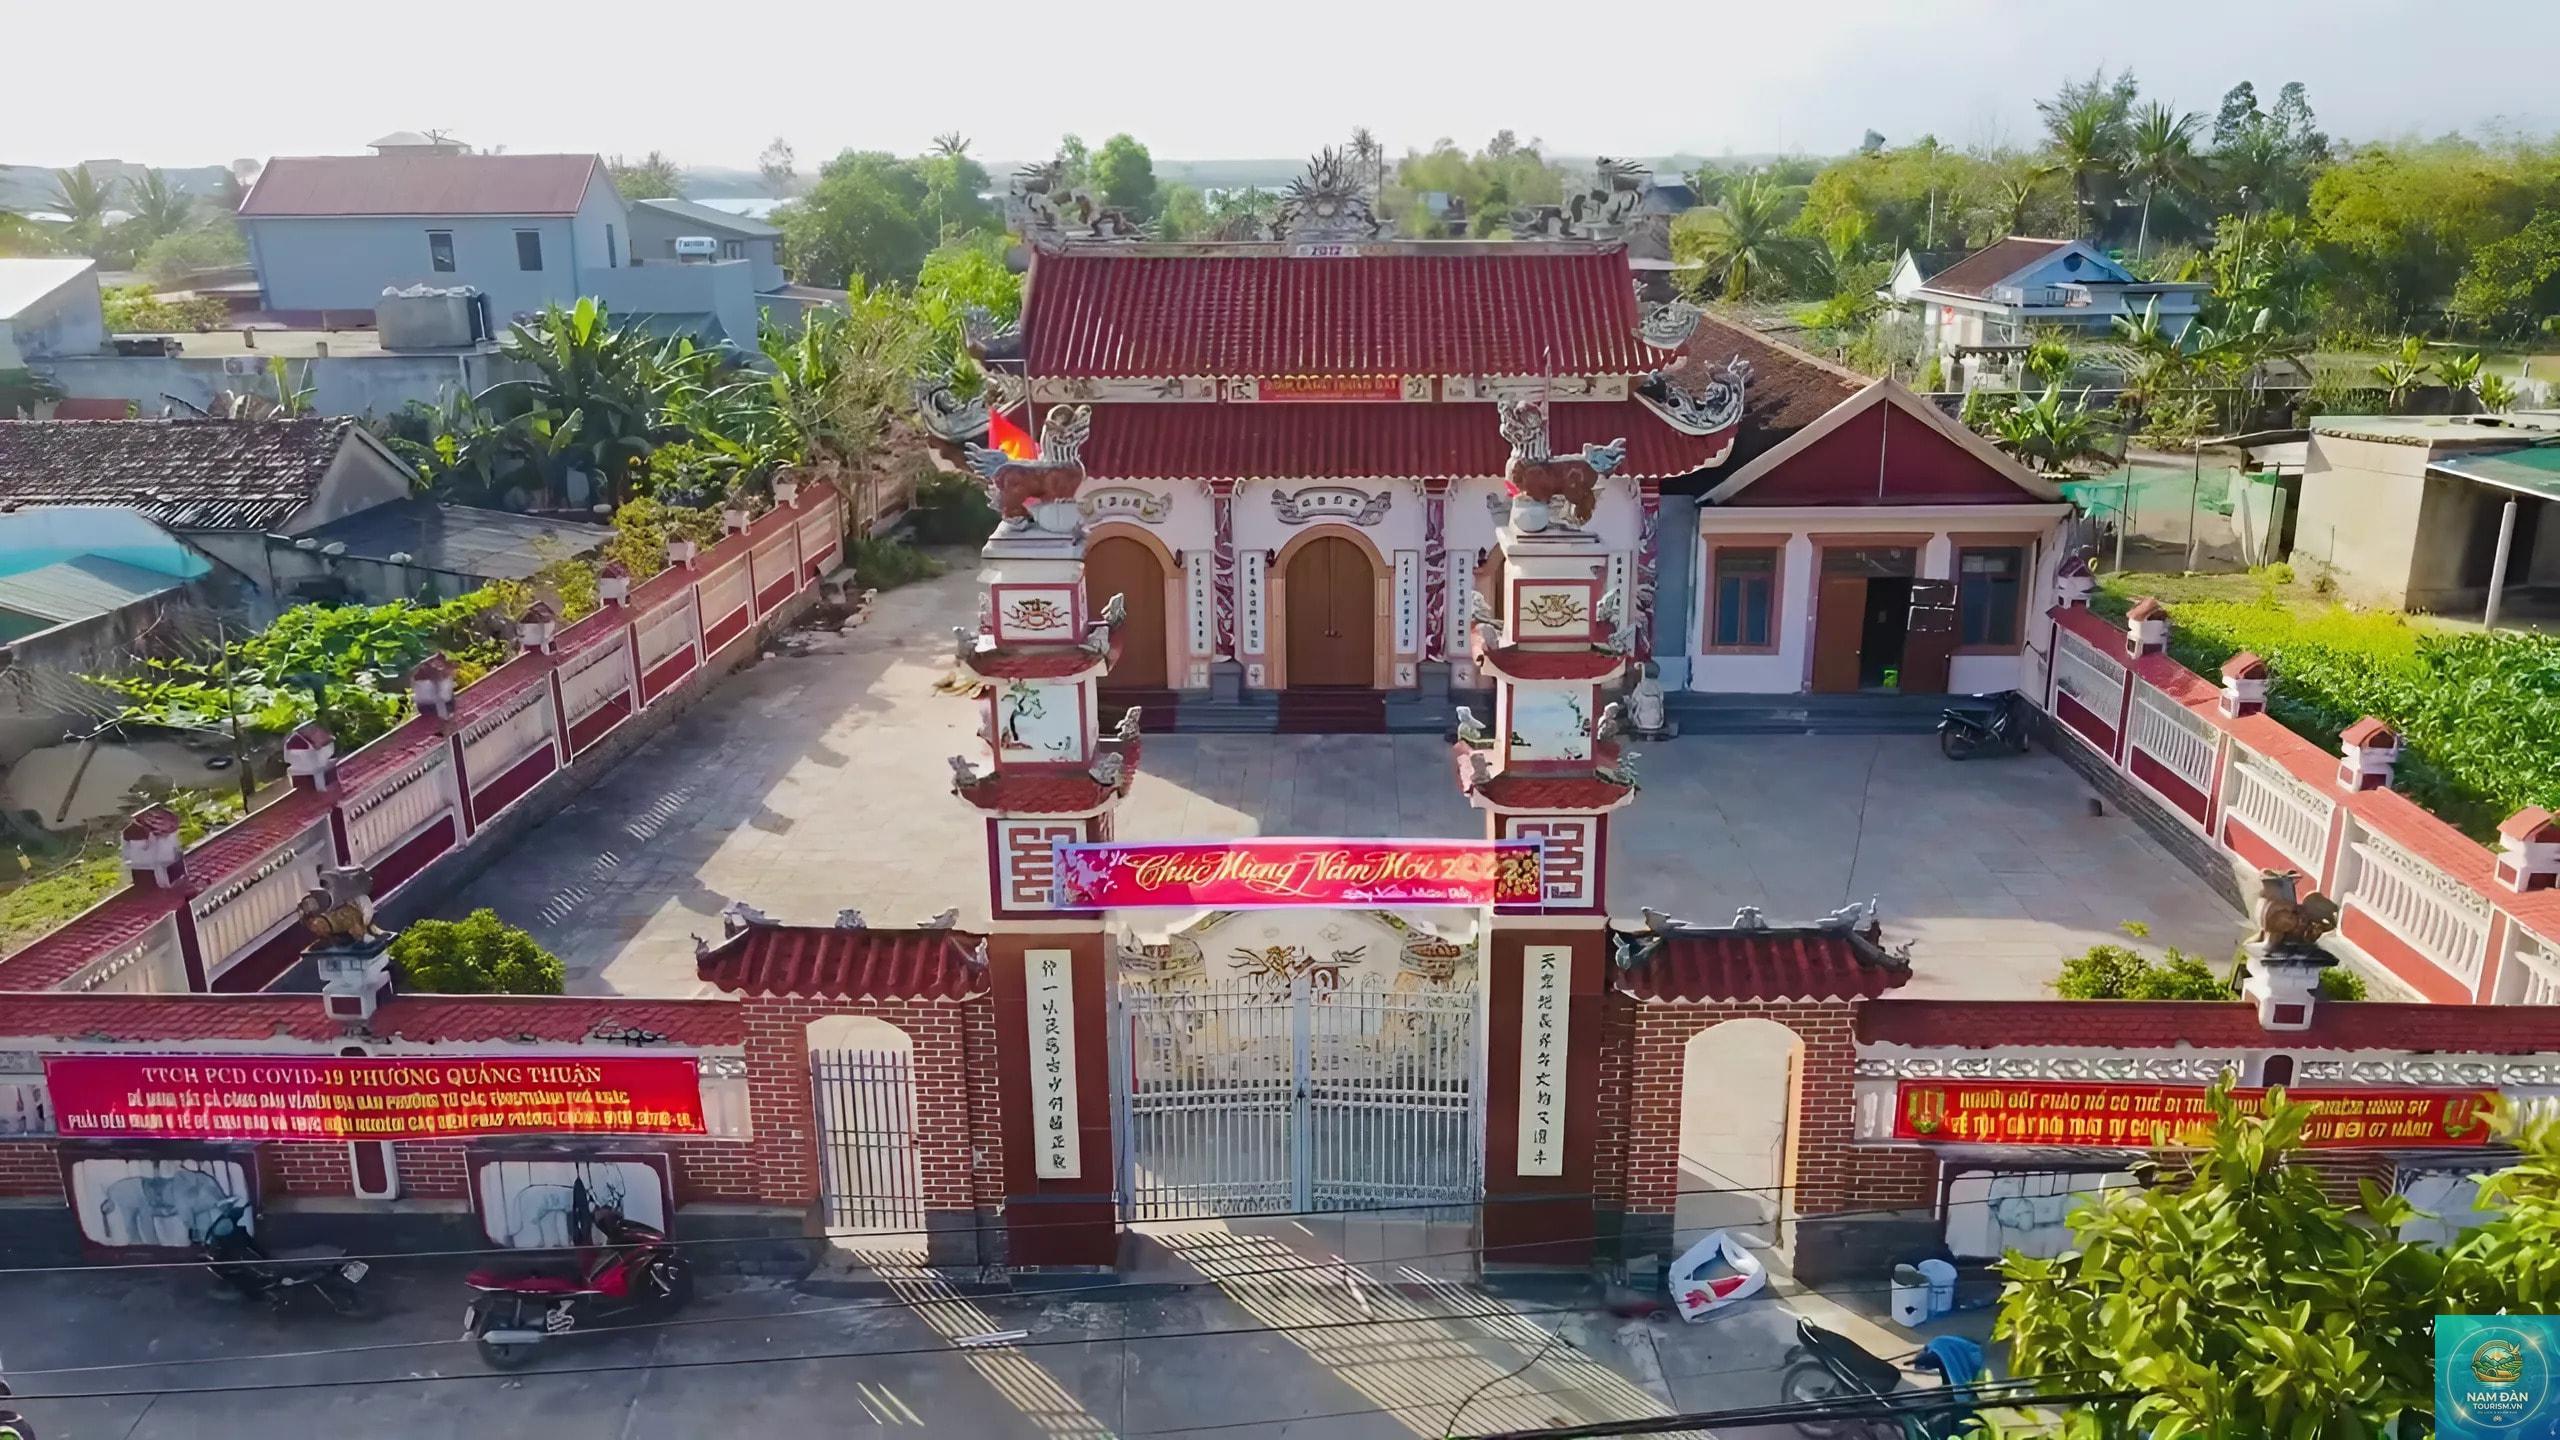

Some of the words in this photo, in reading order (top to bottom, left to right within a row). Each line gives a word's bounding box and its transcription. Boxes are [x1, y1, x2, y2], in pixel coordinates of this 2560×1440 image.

[1124, 851, 1213, 891] Chúc
[1202, 850, 1302, 896] Mừng
[1364, 851, 1438, 887] Mới
[205, 1067, 247, 1085] PCD
[252, 1067, 344, 1086] COVID-19
[350, 1062, 440, 1087] PHƯỜNG
[446, 1062, 522, 1087] QUẢNG
[527, 1063, 602, 1087] THUẬN
